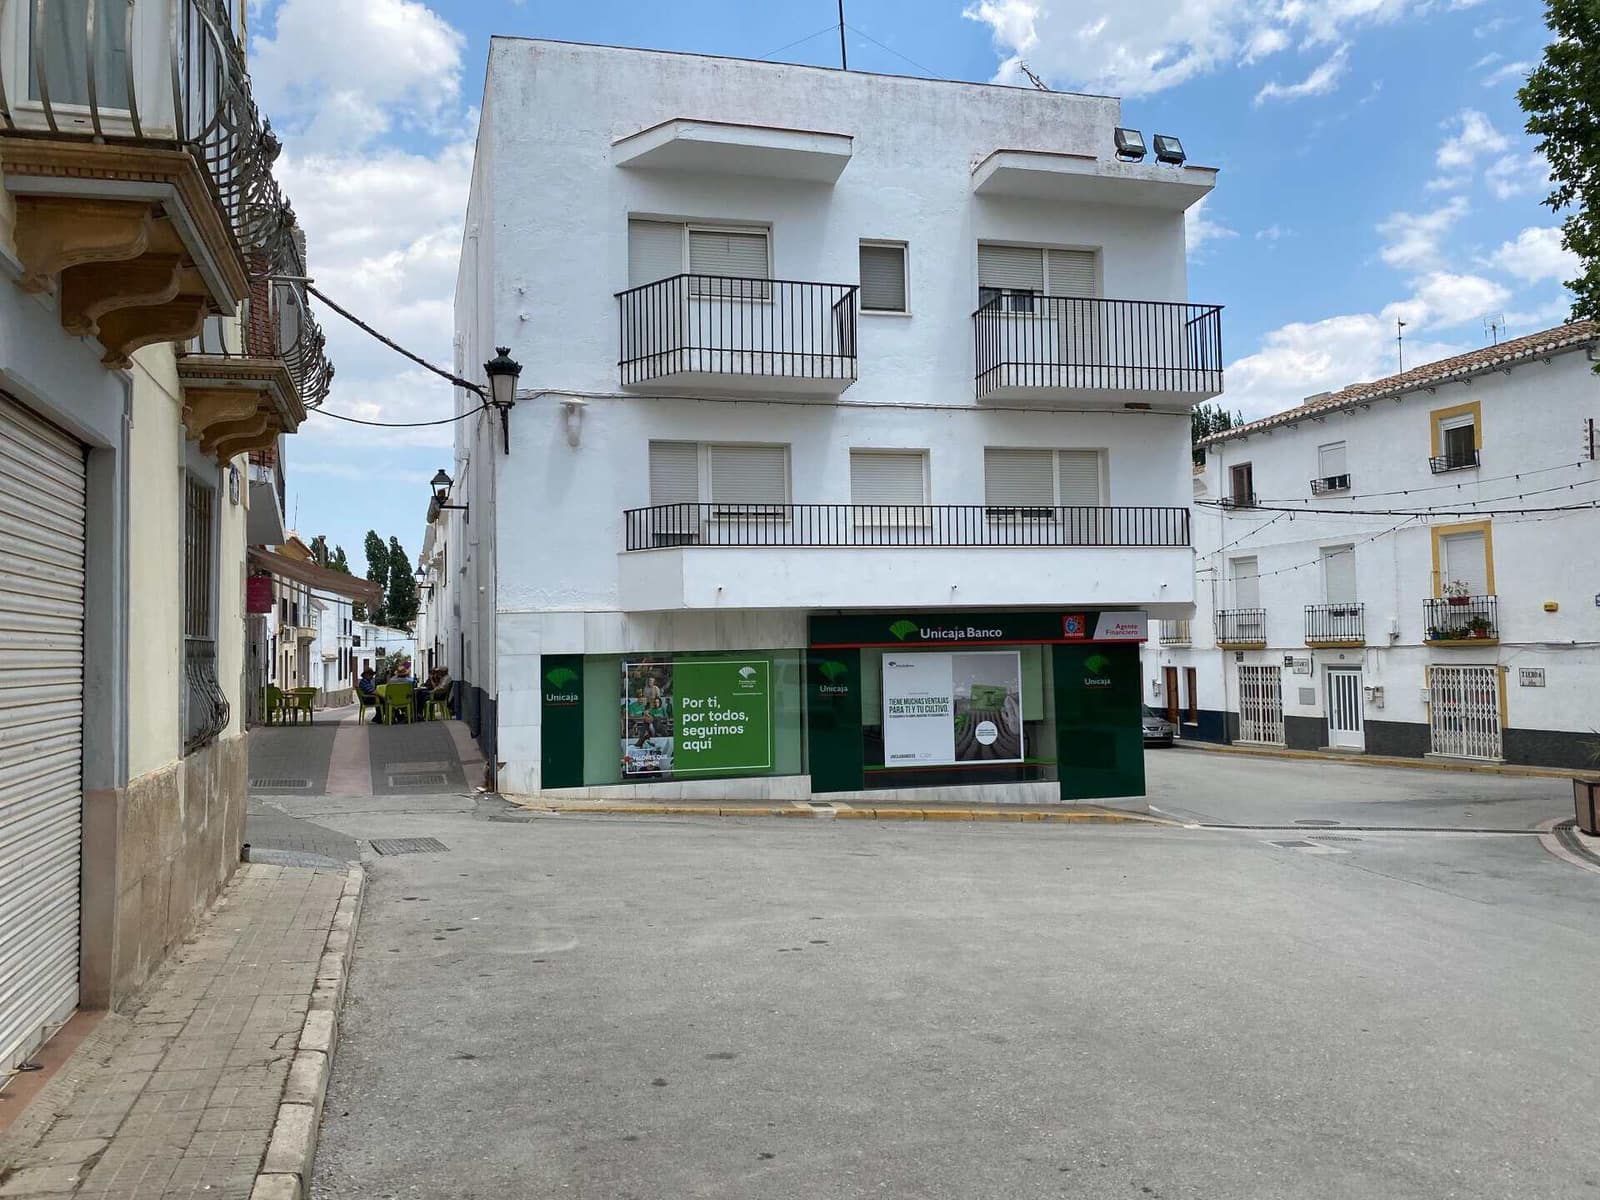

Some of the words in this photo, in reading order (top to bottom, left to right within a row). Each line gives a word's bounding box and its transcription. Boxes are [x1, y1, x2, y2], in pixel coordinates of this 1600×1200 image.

[1115, 623, 1138, 631] Agente
[920, 626, 965, 640] Unicaja
[966, 627, 1002, 638] Banco
[1084, 677, 1111, 686] Unicaja
[820, 684, 849, 694] Unicaja
[546, 693, 579, 702] Unicaja
[682, 697, 704, 708] Por
[707, 696, 721, 708] ti,
[904, 697, 924, 705] MUCHAS
[889, 705, 904, 713] PARA
[917, 705, 924, 713] TU
[682, 713, 705, 725] por
[708, 709, 749, 721] todos,
[682, 723, 744, 739] seguimos
